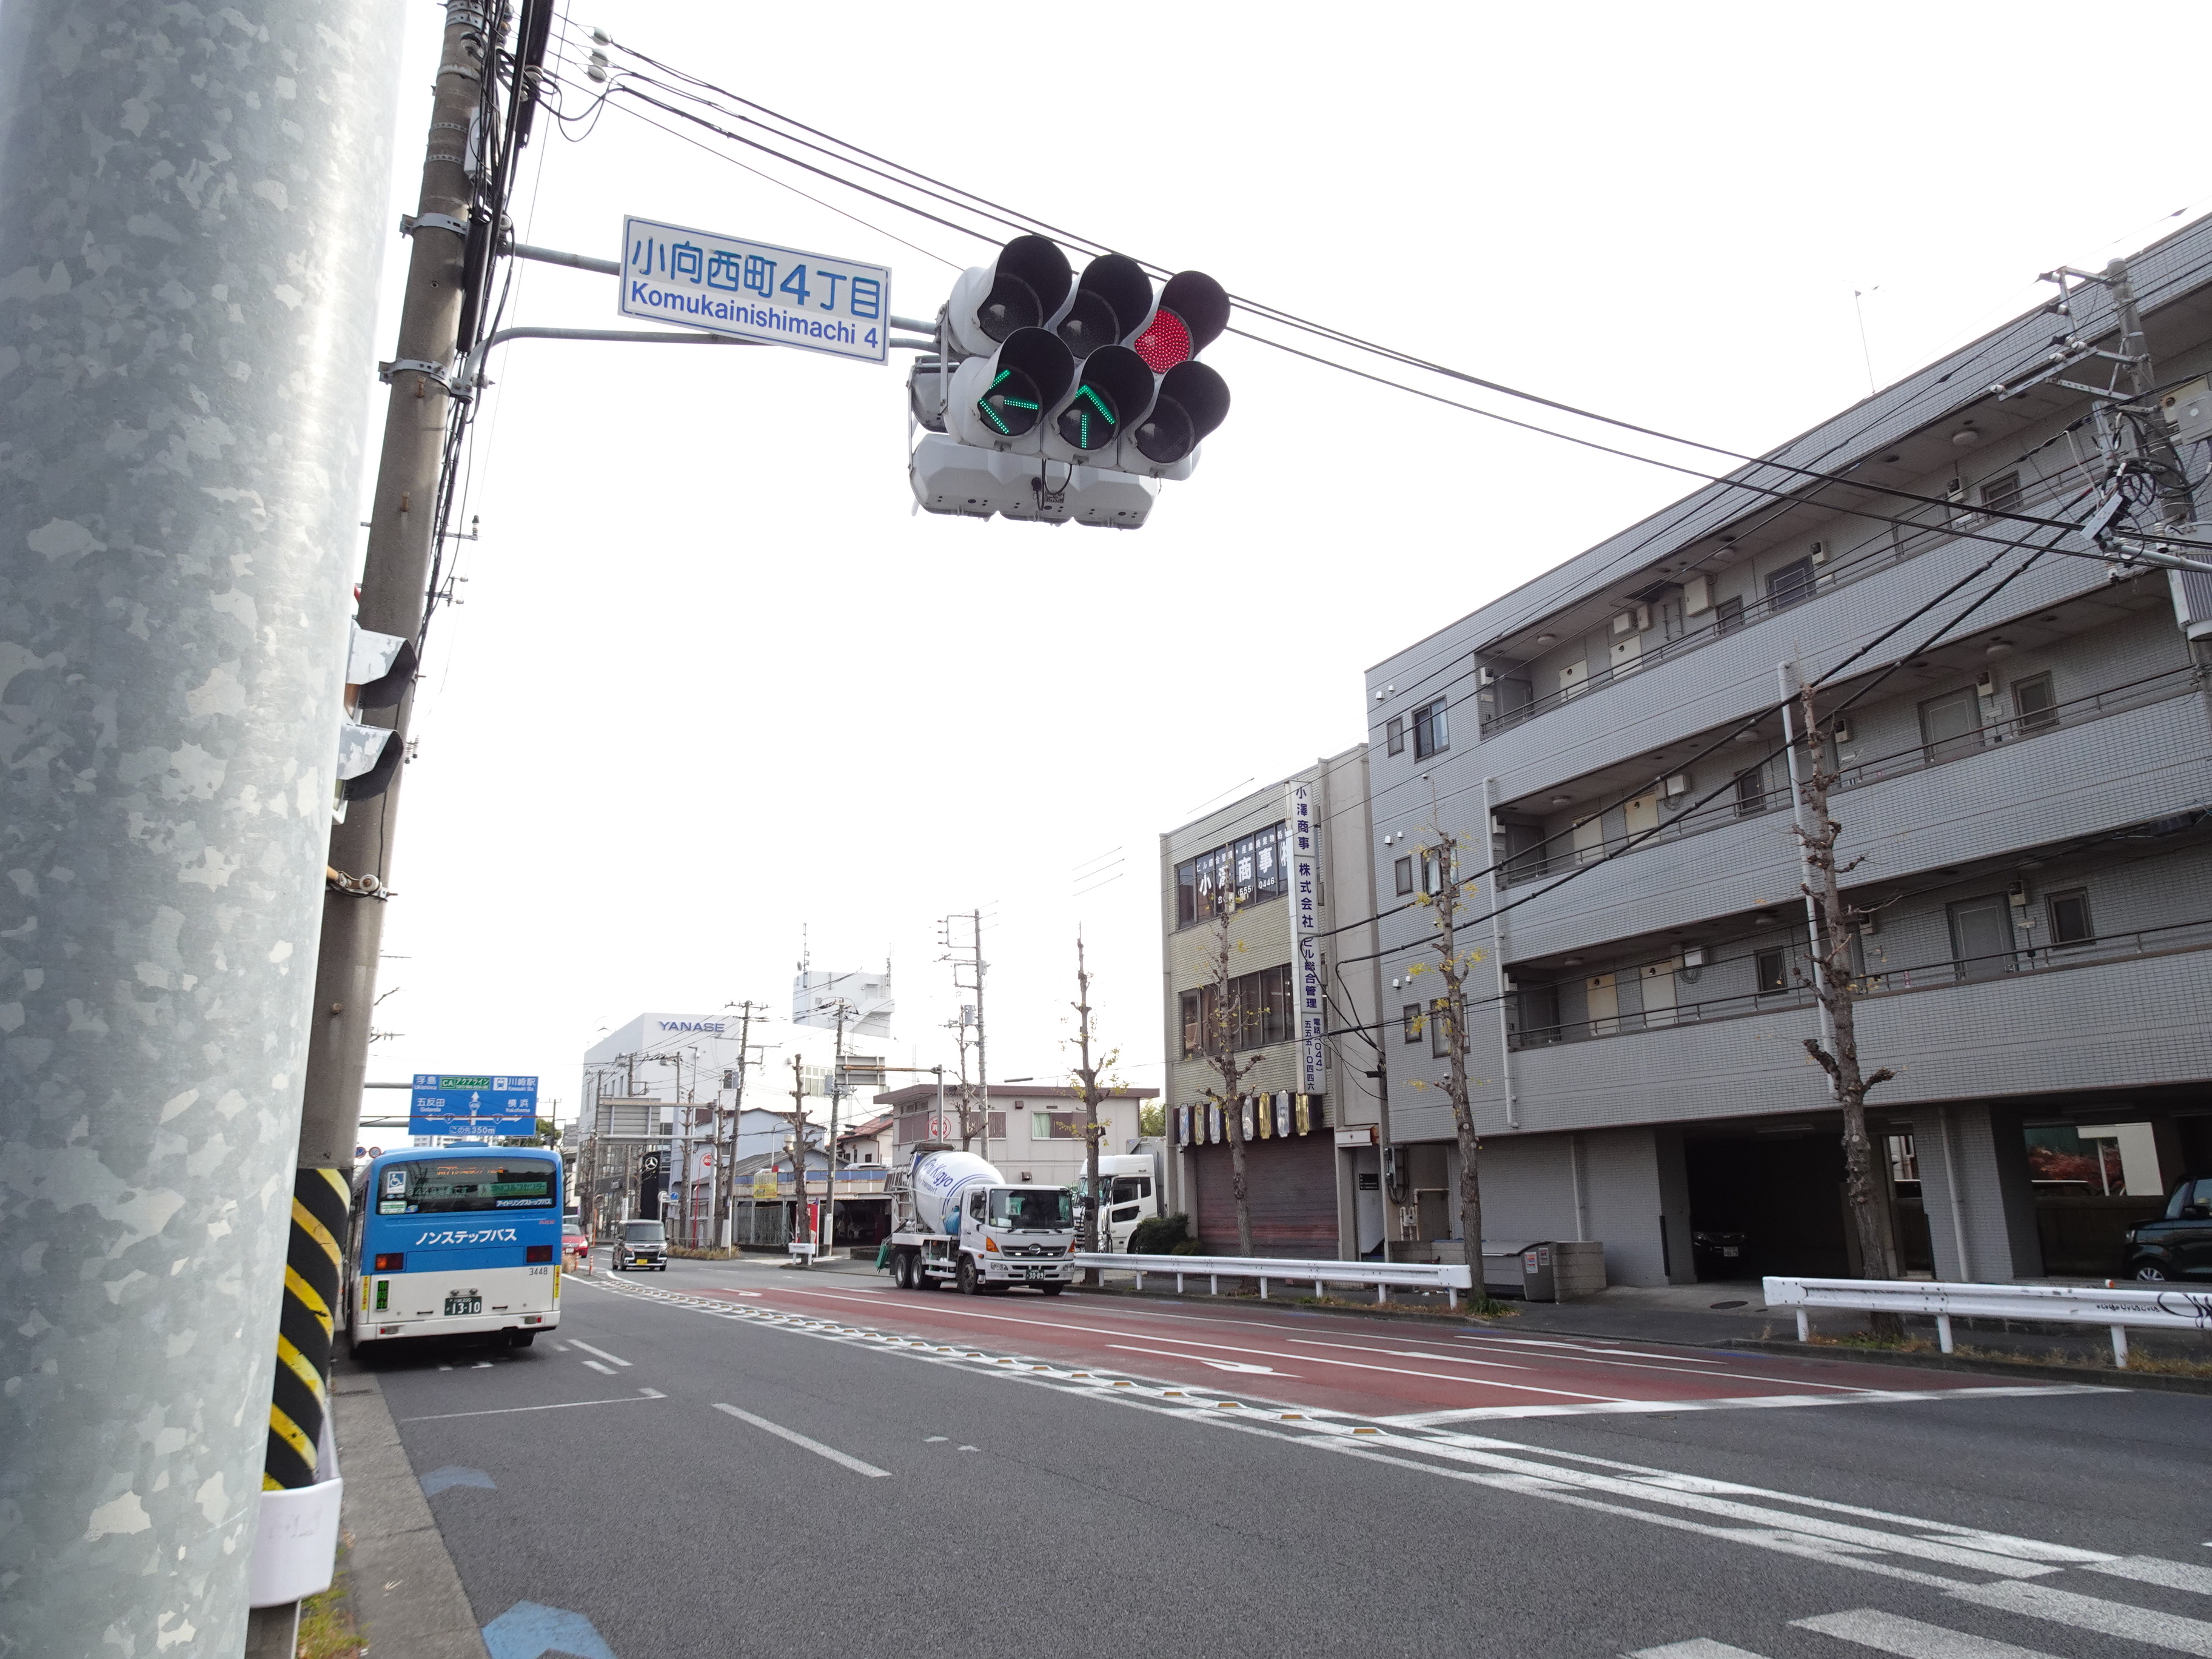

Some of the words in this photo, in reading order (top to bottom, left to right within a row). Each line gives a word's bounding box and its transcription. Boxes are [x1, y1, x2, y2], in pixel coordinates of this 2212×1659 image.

[631, 236, 880, 320] 小向西町4丁目
[631, 280, 855, 344] Komukainishimachi
[864, 327, 879, 349] 4
[1299, 862, 1314, 928] 株式会社
[659, 1021, 725, 1032] YANASE
[508, 1078, 537, 1086] 川崎駅
[417, 1098, 446, 1107] 五反田
[507, 1099, 529, 1107] 横浜
[415, 1228, 517, 1245] ノンステップバス
[529, 1267, 548, 1276] 3448
[452, 1301, 481, 1315] 13-10
